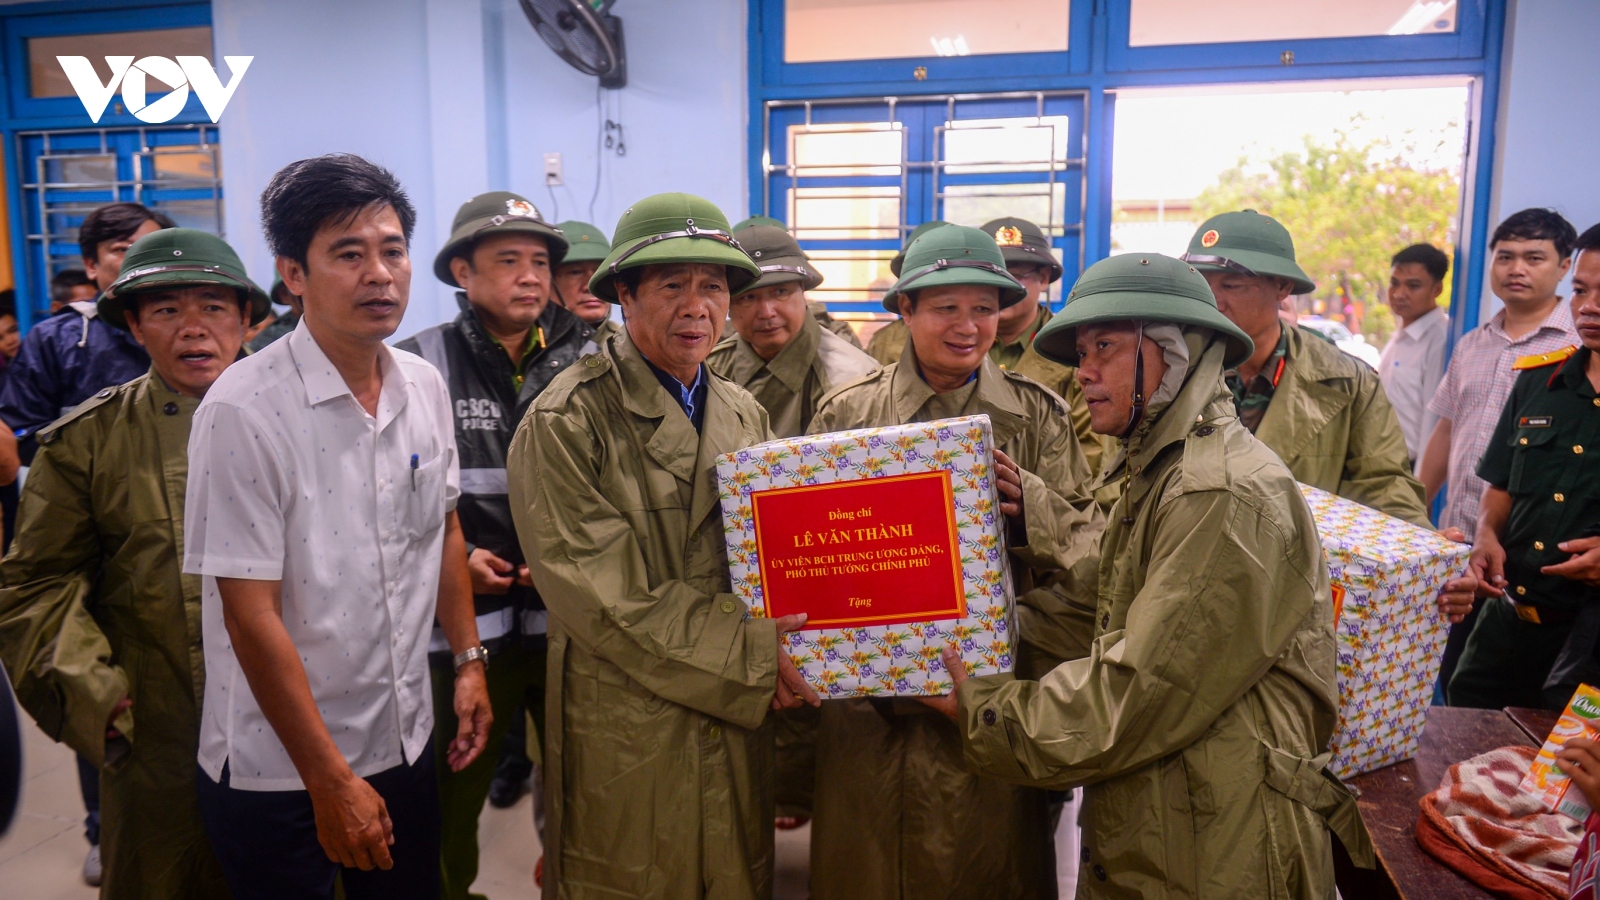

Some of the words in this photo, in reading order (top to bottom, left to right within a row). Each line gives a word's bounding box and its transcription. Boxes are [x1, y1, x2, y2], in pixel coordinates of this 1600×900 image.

[462, 418, 498, 430] POLICE
[828, 508, 855, 520] Đồng
[857, 507, 872, 517] chí
[793, 530, 814, 548] LÊ
[817, 528, 851, 545] VĂN
[854, 523, 913, 541] THÀNH
[771, 558, 785, 569] ỦY
[787, 556, 812, 567] VIÊN
[814, 555, 835, 565] BCH
[837, 551, 874, 563] TRUNG
[876, 548, 908, 558] ƯƠNG
[910, 544, 944, 556] ĐẢNG,
[785, 567, 807, 579] PHÓ
[808, 566, 829, 577] THỦ
[831, 563, 869, 575] TƯỚNG
[871, 559, 907, 572] CHÍNH
[908, 556, 931, 568] PHỦ
[848, 597, 872, 608] Tặng
